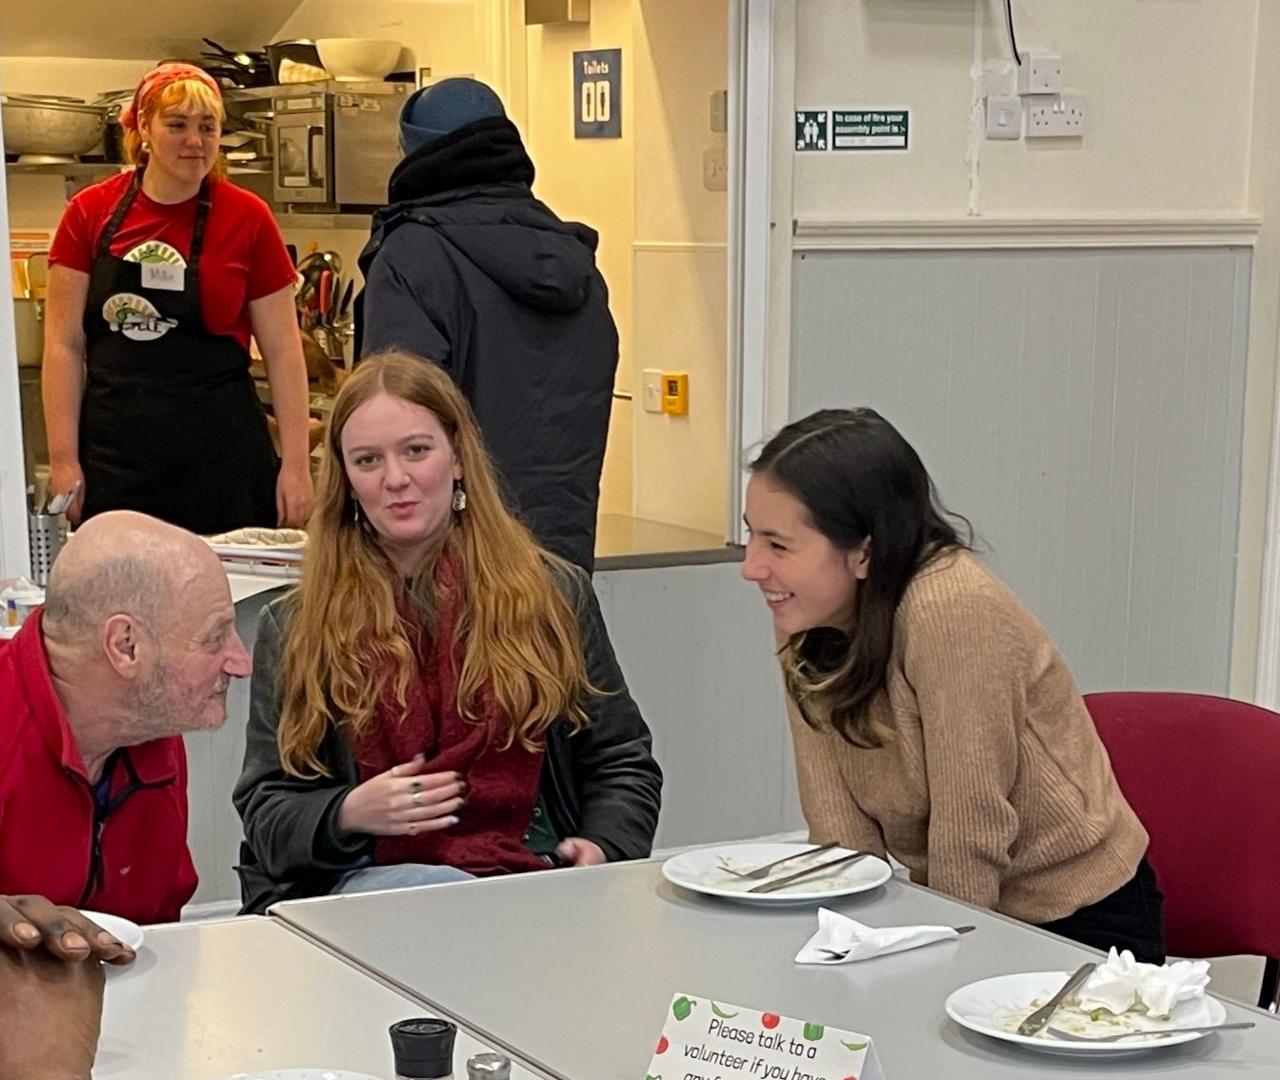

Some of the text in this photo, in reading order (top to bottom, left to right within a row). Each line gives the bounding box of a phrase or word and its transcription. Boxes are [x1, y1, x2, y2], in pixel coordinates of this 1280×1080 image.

[863, 113, 872, 122] of
[872, 113, 885, 122] fire
[834, 125, 870, 135] assembly
[871, 125, 891, 135] point
[708, 1018, 817, 1060] Please talk to a
[684, 1044, 749, 1071] volunteer
[749, 1057, 764, 1074] if
[760, 1064, 790, 1080] you
